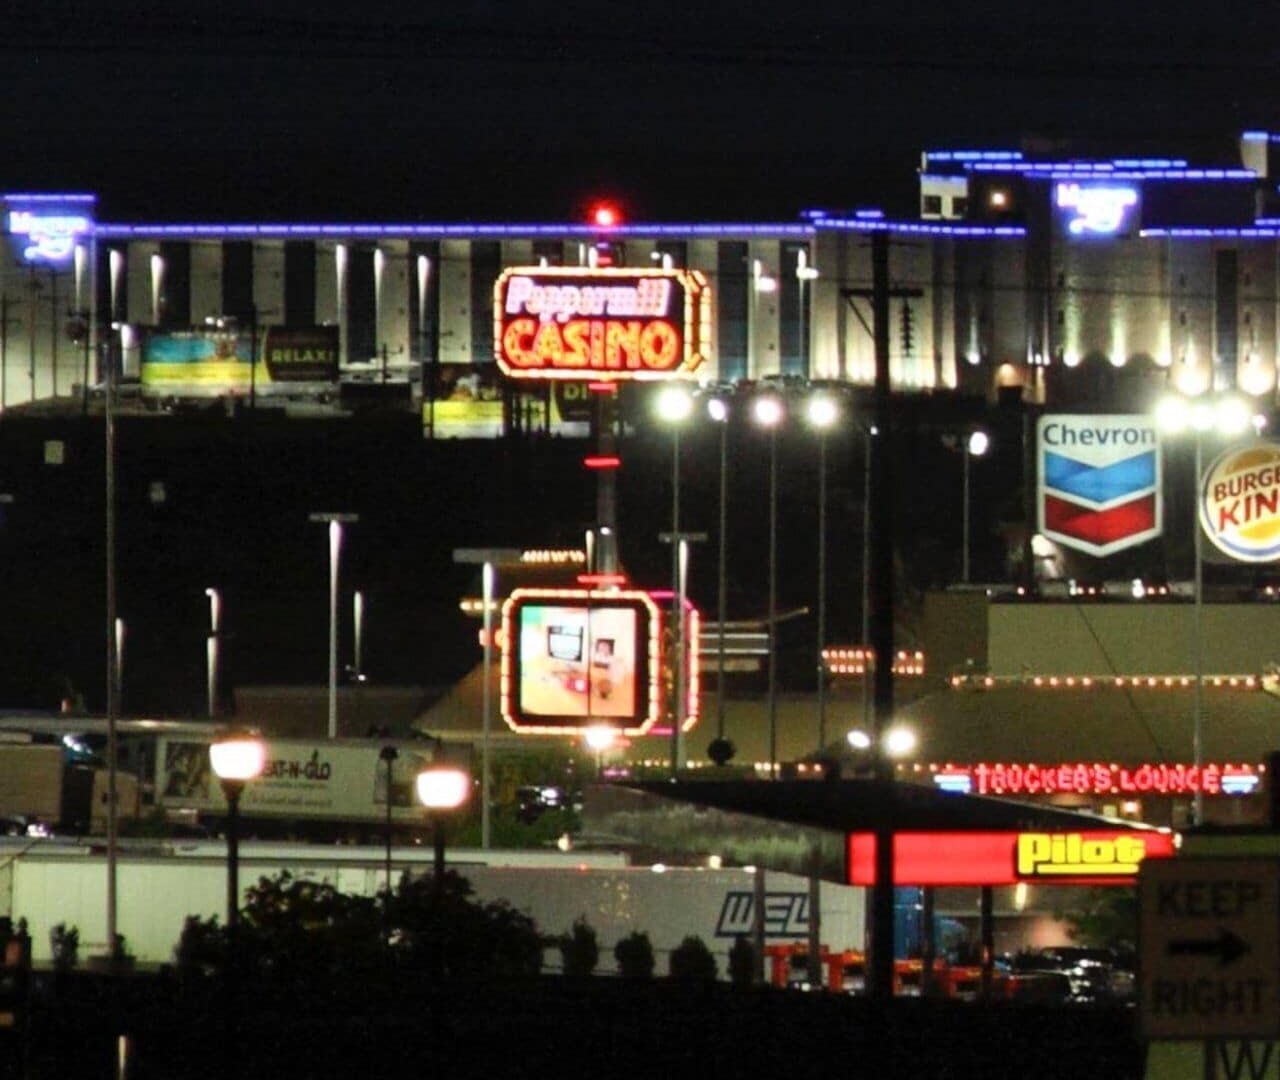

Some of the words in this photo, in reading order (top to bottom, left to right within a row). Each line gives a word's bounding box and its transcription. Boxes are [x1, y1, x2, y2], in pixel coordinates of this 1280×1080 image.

[506, 277, 670, 323] Peppermill
[504, 318, 679, 368] CASINO
[1043, 423, 1158, 447] Chevron
[976, 768, 1114, 793] TRUCKER'S
[1018, 833, 1146, 874] Pilot
[1155, 880, 1261, 915] KEEP
[1153, 977, 1267, 1013] RIGHT
